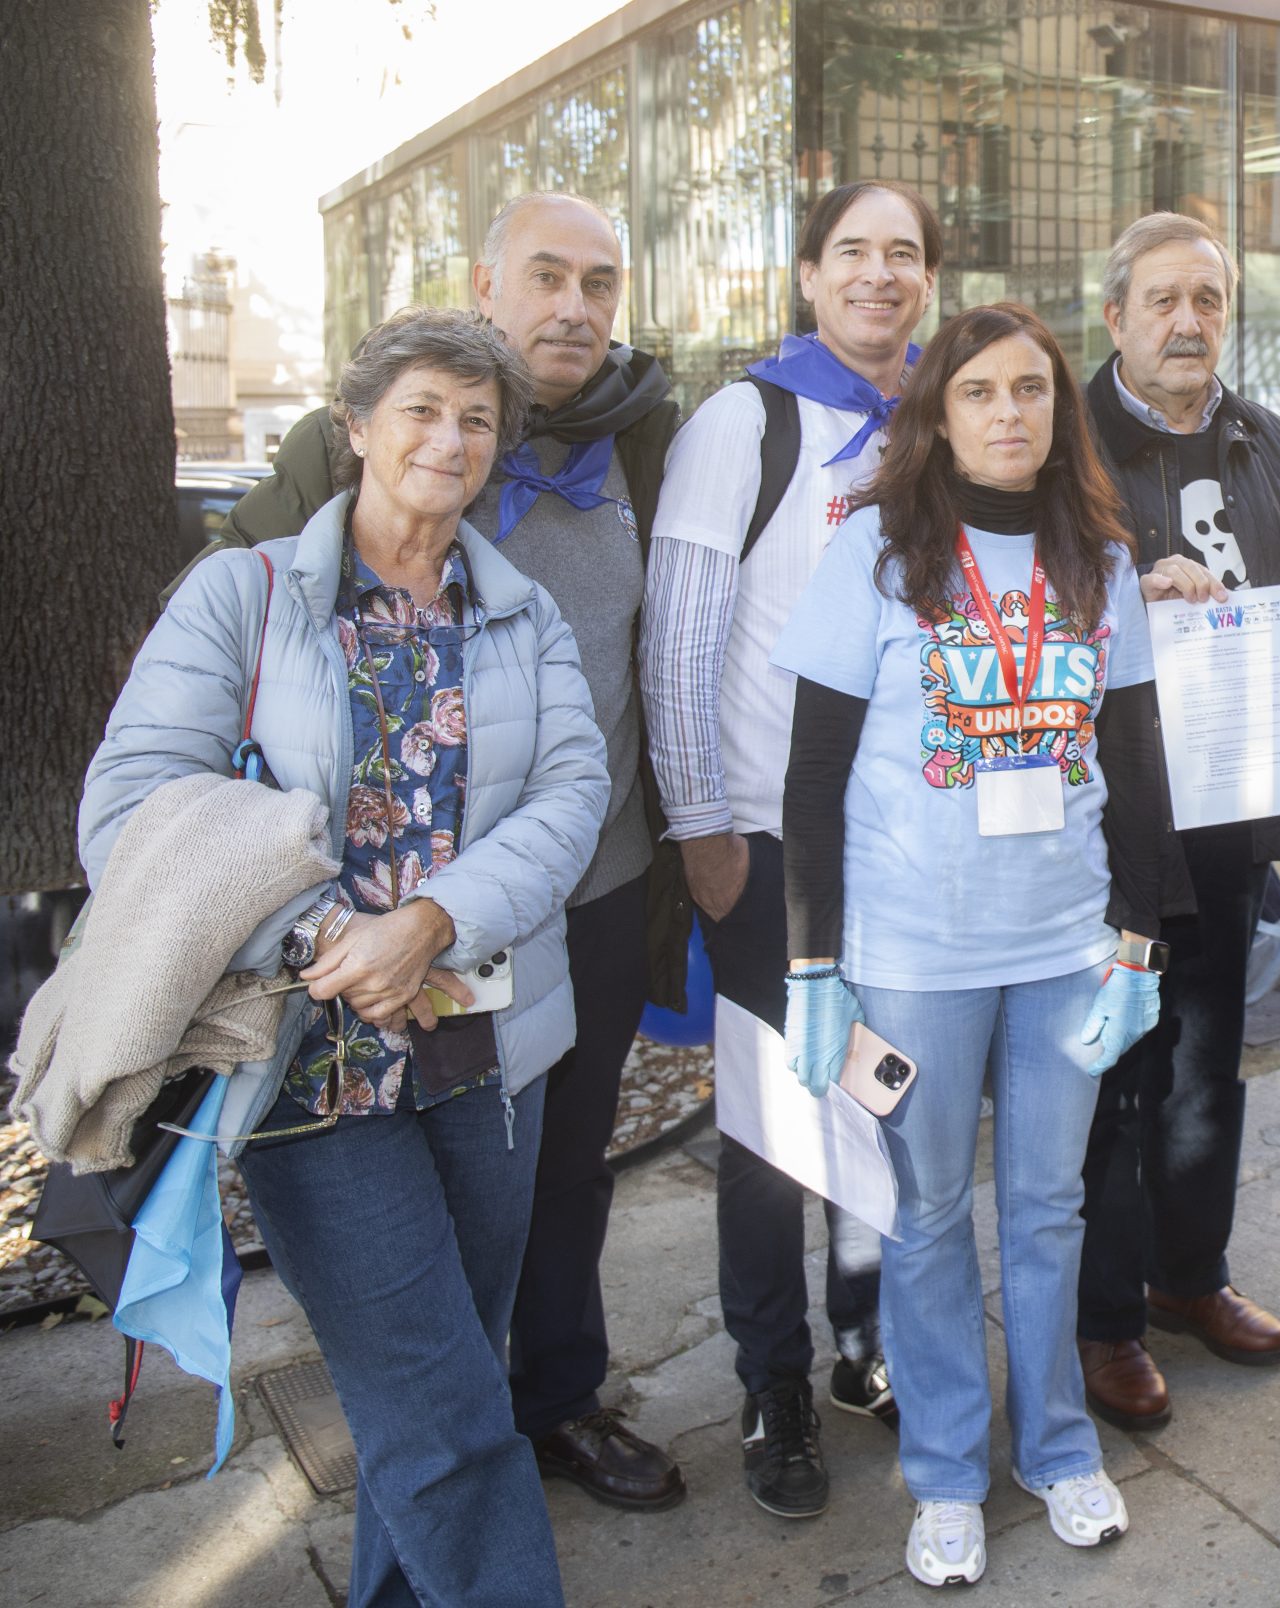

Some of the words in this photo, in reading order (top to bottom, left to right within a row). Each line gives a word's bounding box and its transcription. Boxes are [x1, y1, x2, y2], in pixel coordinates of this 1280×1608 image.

[1217, 613, 1235, 628] YA
[947, 645, 1096, 701] VETS
[975, 704, 1077, 733] UNIDOS
